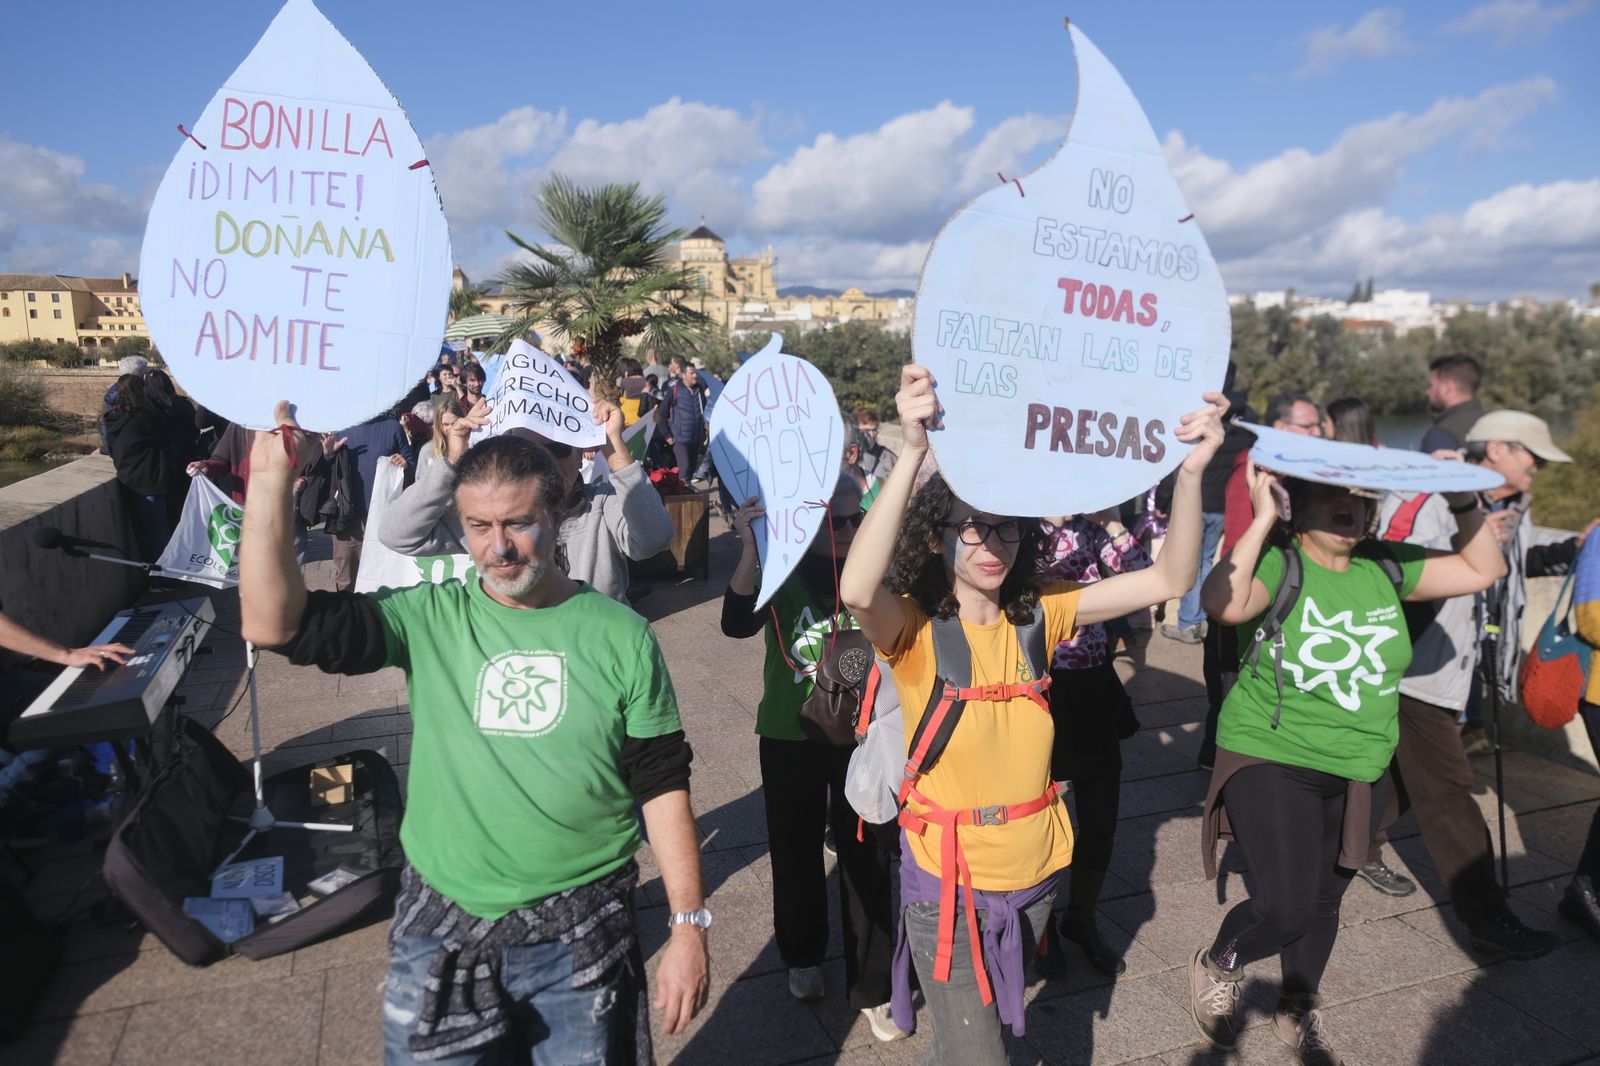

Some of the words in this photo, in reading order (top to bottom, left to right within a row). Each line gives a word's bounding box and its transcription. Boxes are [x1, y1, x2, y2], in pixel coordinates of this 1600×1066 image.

[220, 97, 394, 159] BONILLA
[188, 160, 364, 221] ¡DIMITE!
[1088, 168, 1134, 214] NO
[214, 210, 395, 262] DOÑANA
[1033, 217, 1200, 282] ESTAMOS
[170, 258, 227, 299] NO
[290, 265, 348, 312] TE
[1057, 277, 1171, 333] TODAS,
[194, 309, 344, 371] ADMITE
[936, 309, 1062, 362] FALTAN
[1081, 332, 1140, 373] LAS
[1154, 344, 1192, 382] DE
[501, 353, 565, 384] AGUA
[723, 361, 816, 416] VIDA
[955, 358, 1018, 399] LAS
[488, 398, 582, 437] HUMANO
[737, 412, 773, 440] HAY
[786, 398, 811, 424] NO
[1024, 403, 1166, 464] PRESAS
[716, 416, 833, 499] AGUA
[763, 505, 810, 544] SIN
[254, 863, 275, 887] DISCO
